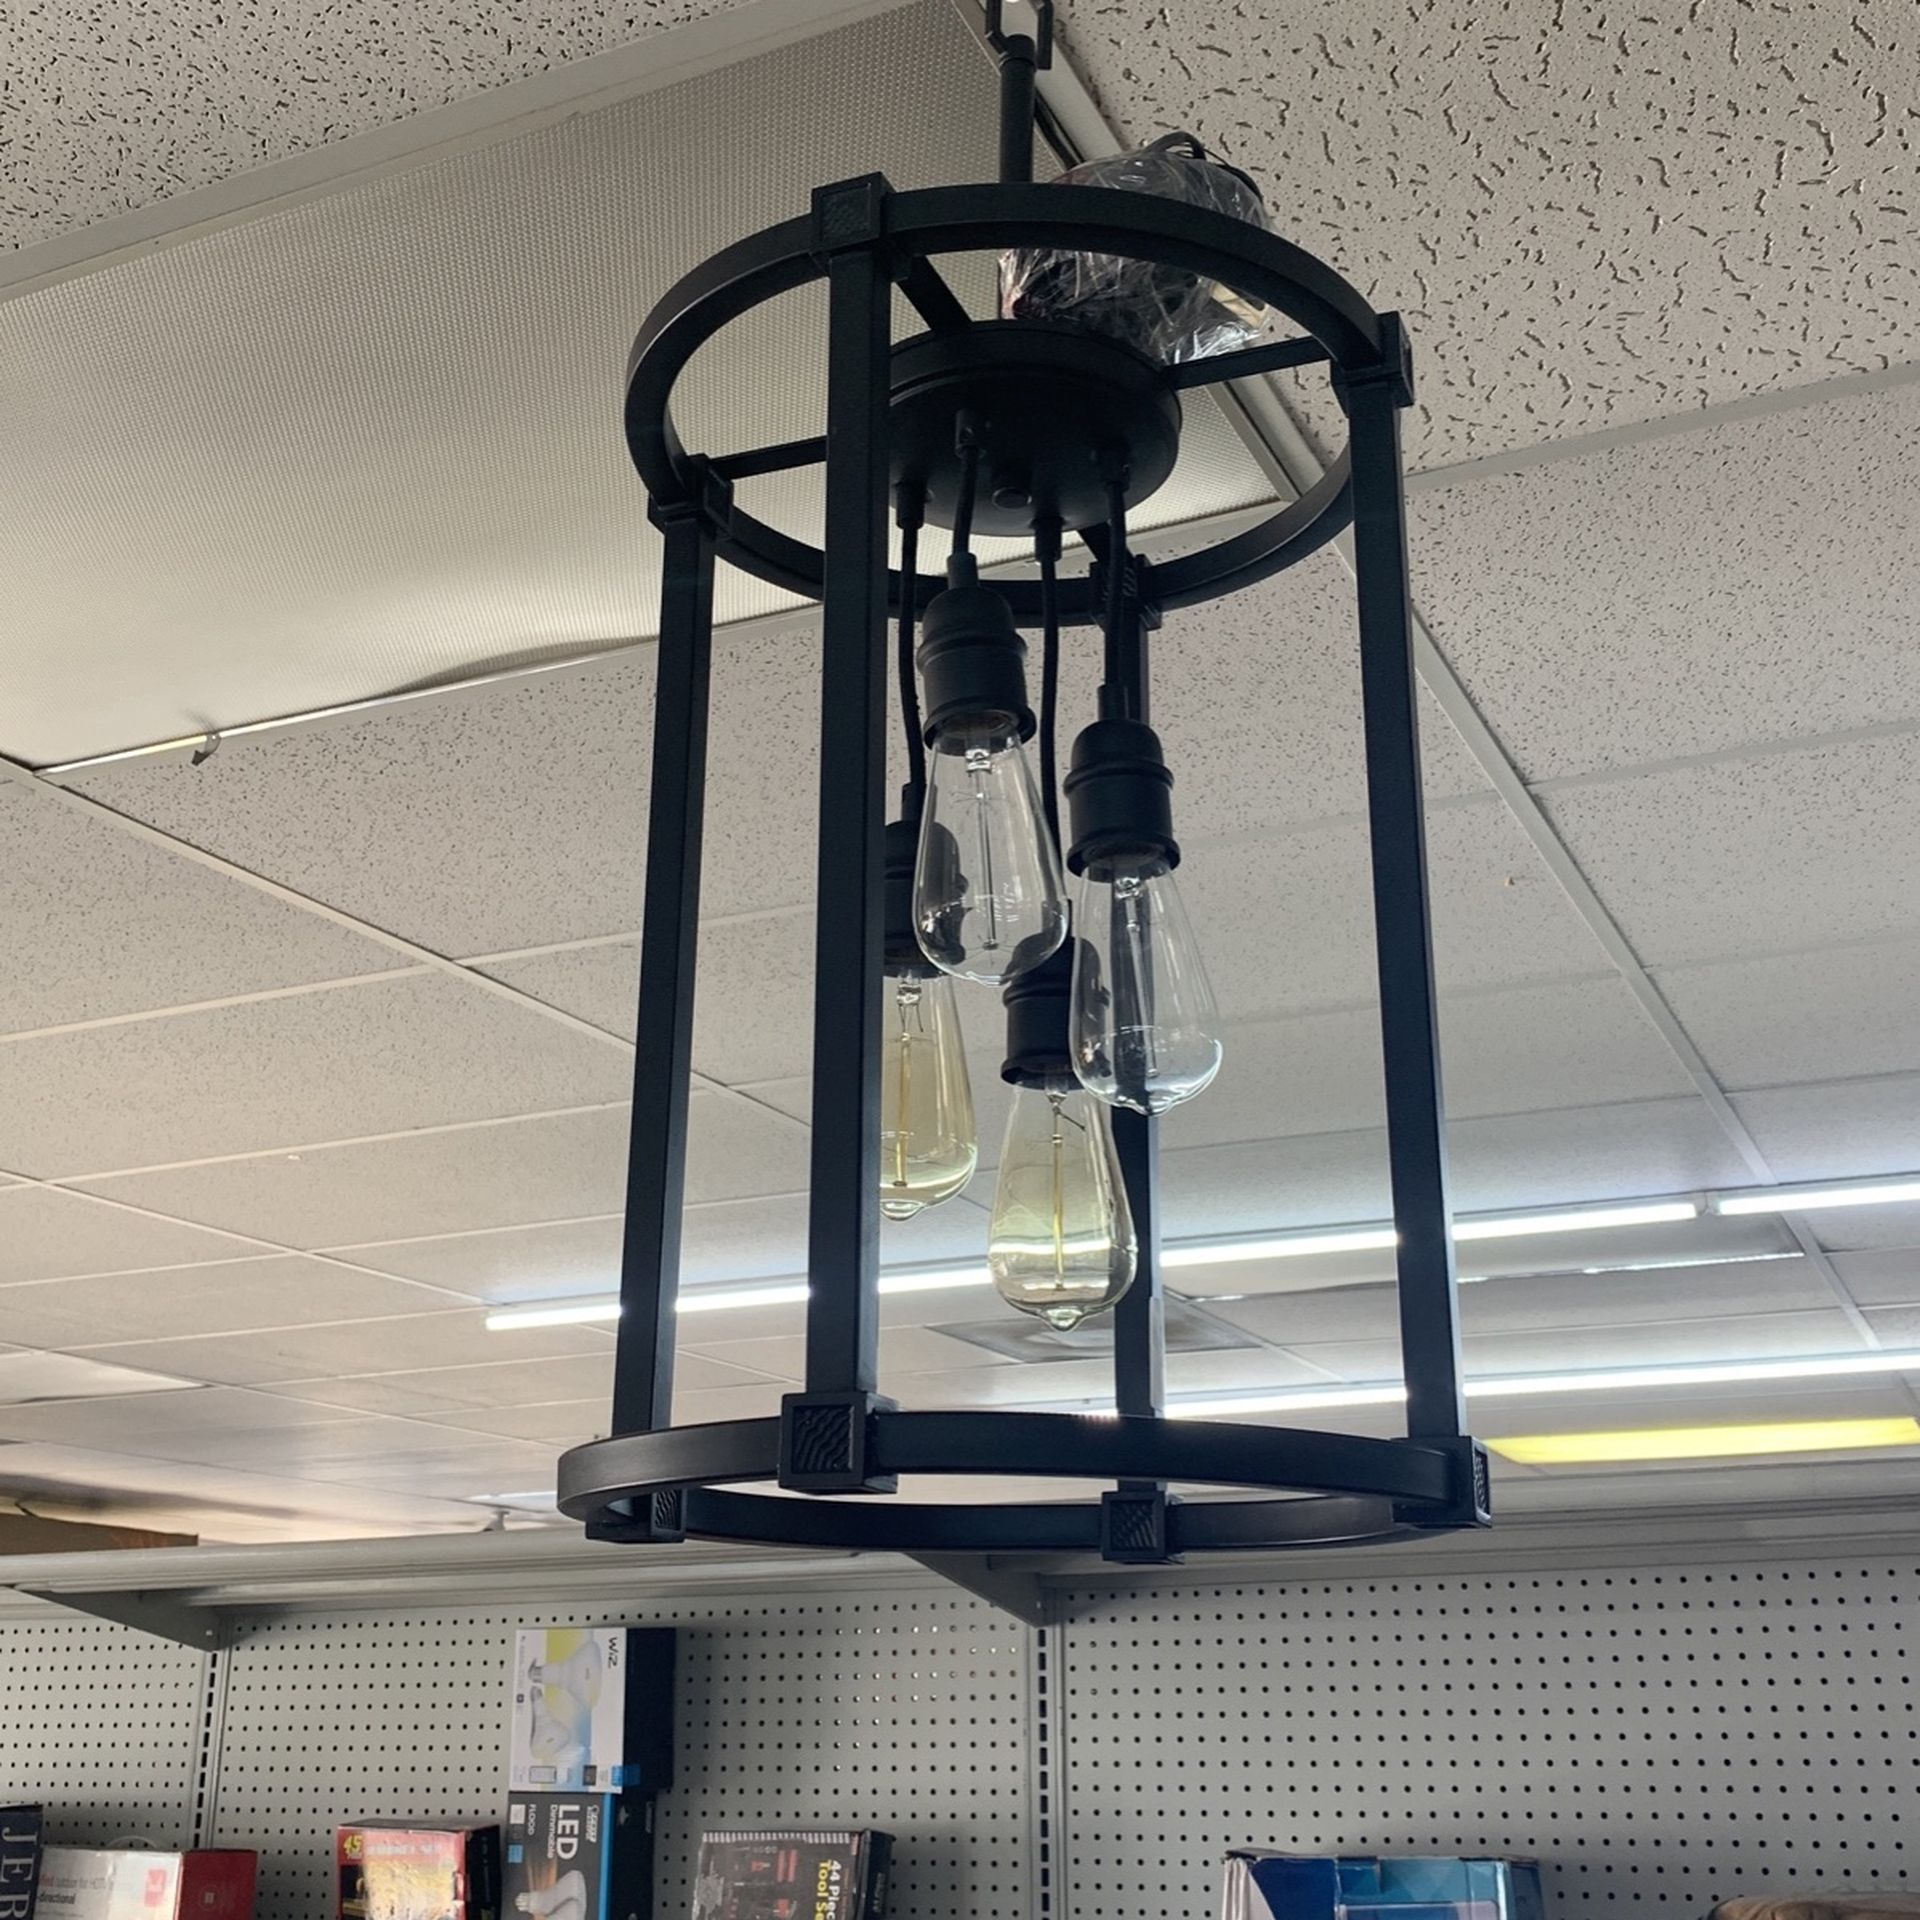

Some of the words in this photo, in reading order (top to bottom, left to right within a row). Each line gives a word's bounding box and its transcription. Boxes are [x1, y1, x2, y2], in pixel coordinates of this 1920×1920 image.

[527, 1804, 537, 1836] FLOOD
[547, 1804, 558, 1859] Dimmable
[556, 1804, 580, 1860] LED
[343, 1835, 363, 1853] 45
[817, 1859, 832, 1897] Tool
[829, 1860, 842, 1882] 44
